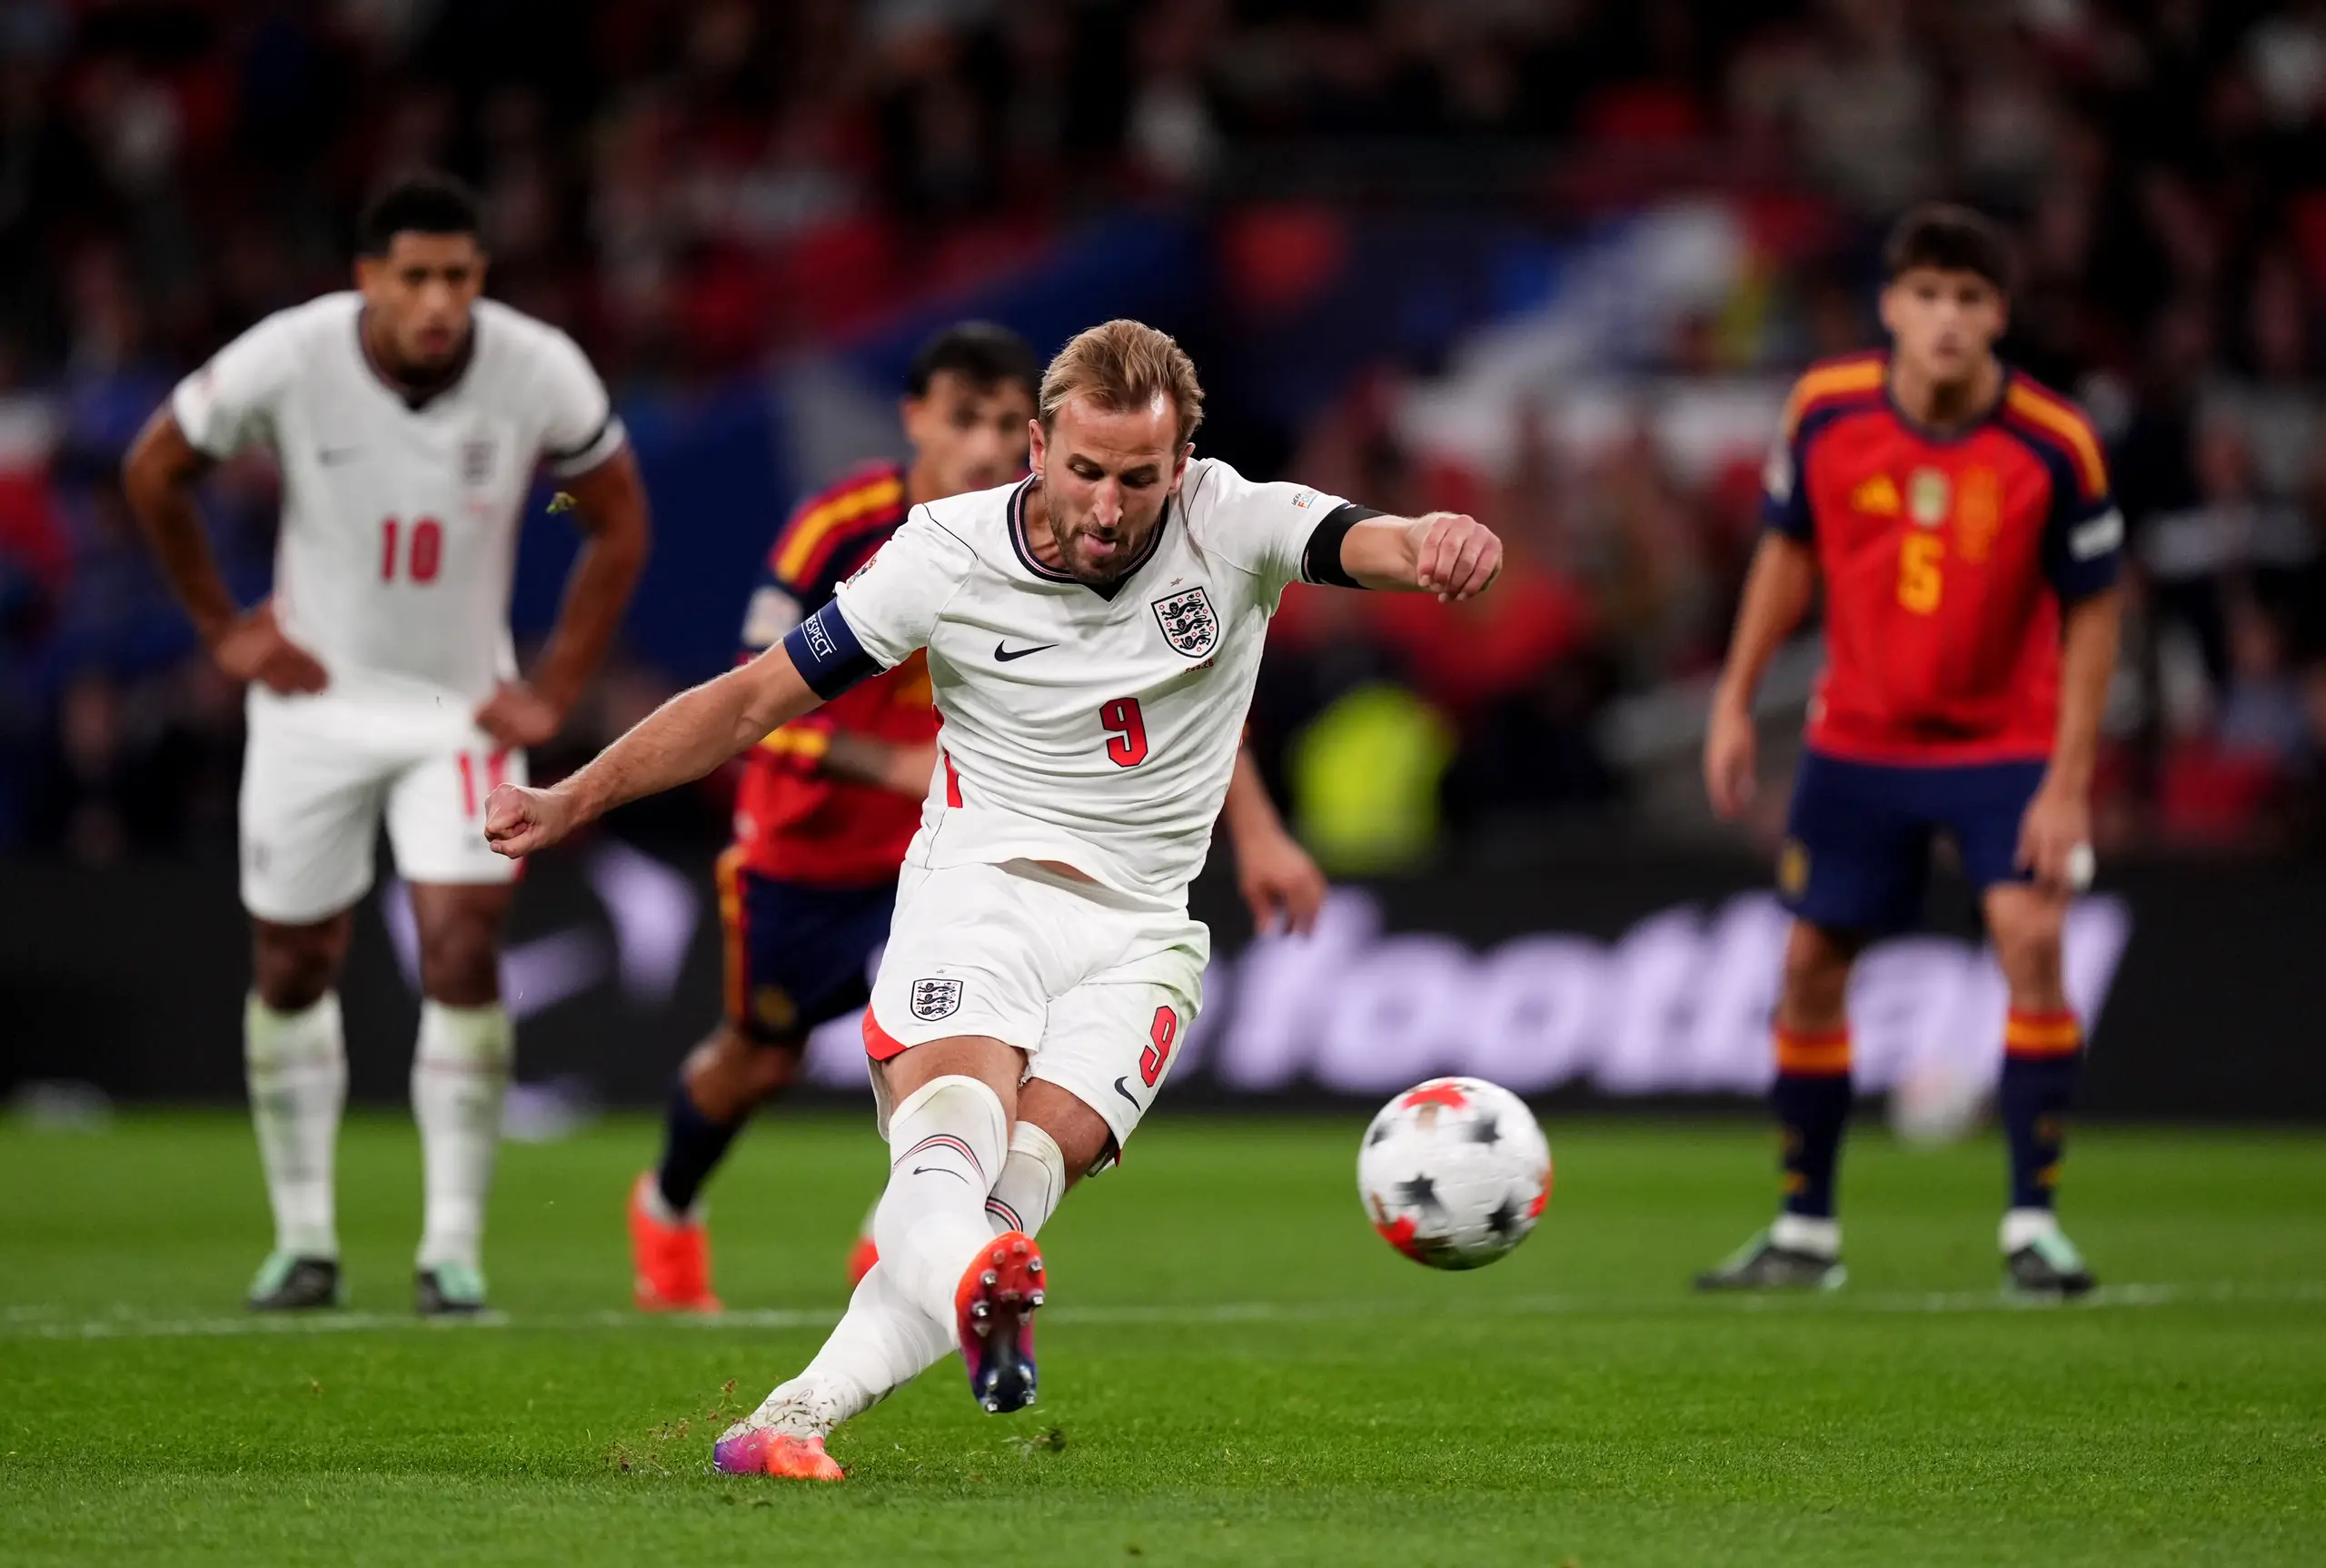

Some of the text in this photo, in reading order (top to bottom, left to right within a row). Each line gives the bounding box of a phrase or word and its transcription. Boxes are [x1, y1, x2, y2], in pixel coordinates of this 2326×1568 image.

[380, 517, 442, 584] 10
[1897, 532, 1944, 614] 5
[1098, 697, 1148, 768] 9
[804, 886, 2132, 1092] football
[1138, 1005, 1177, 1088] 9
